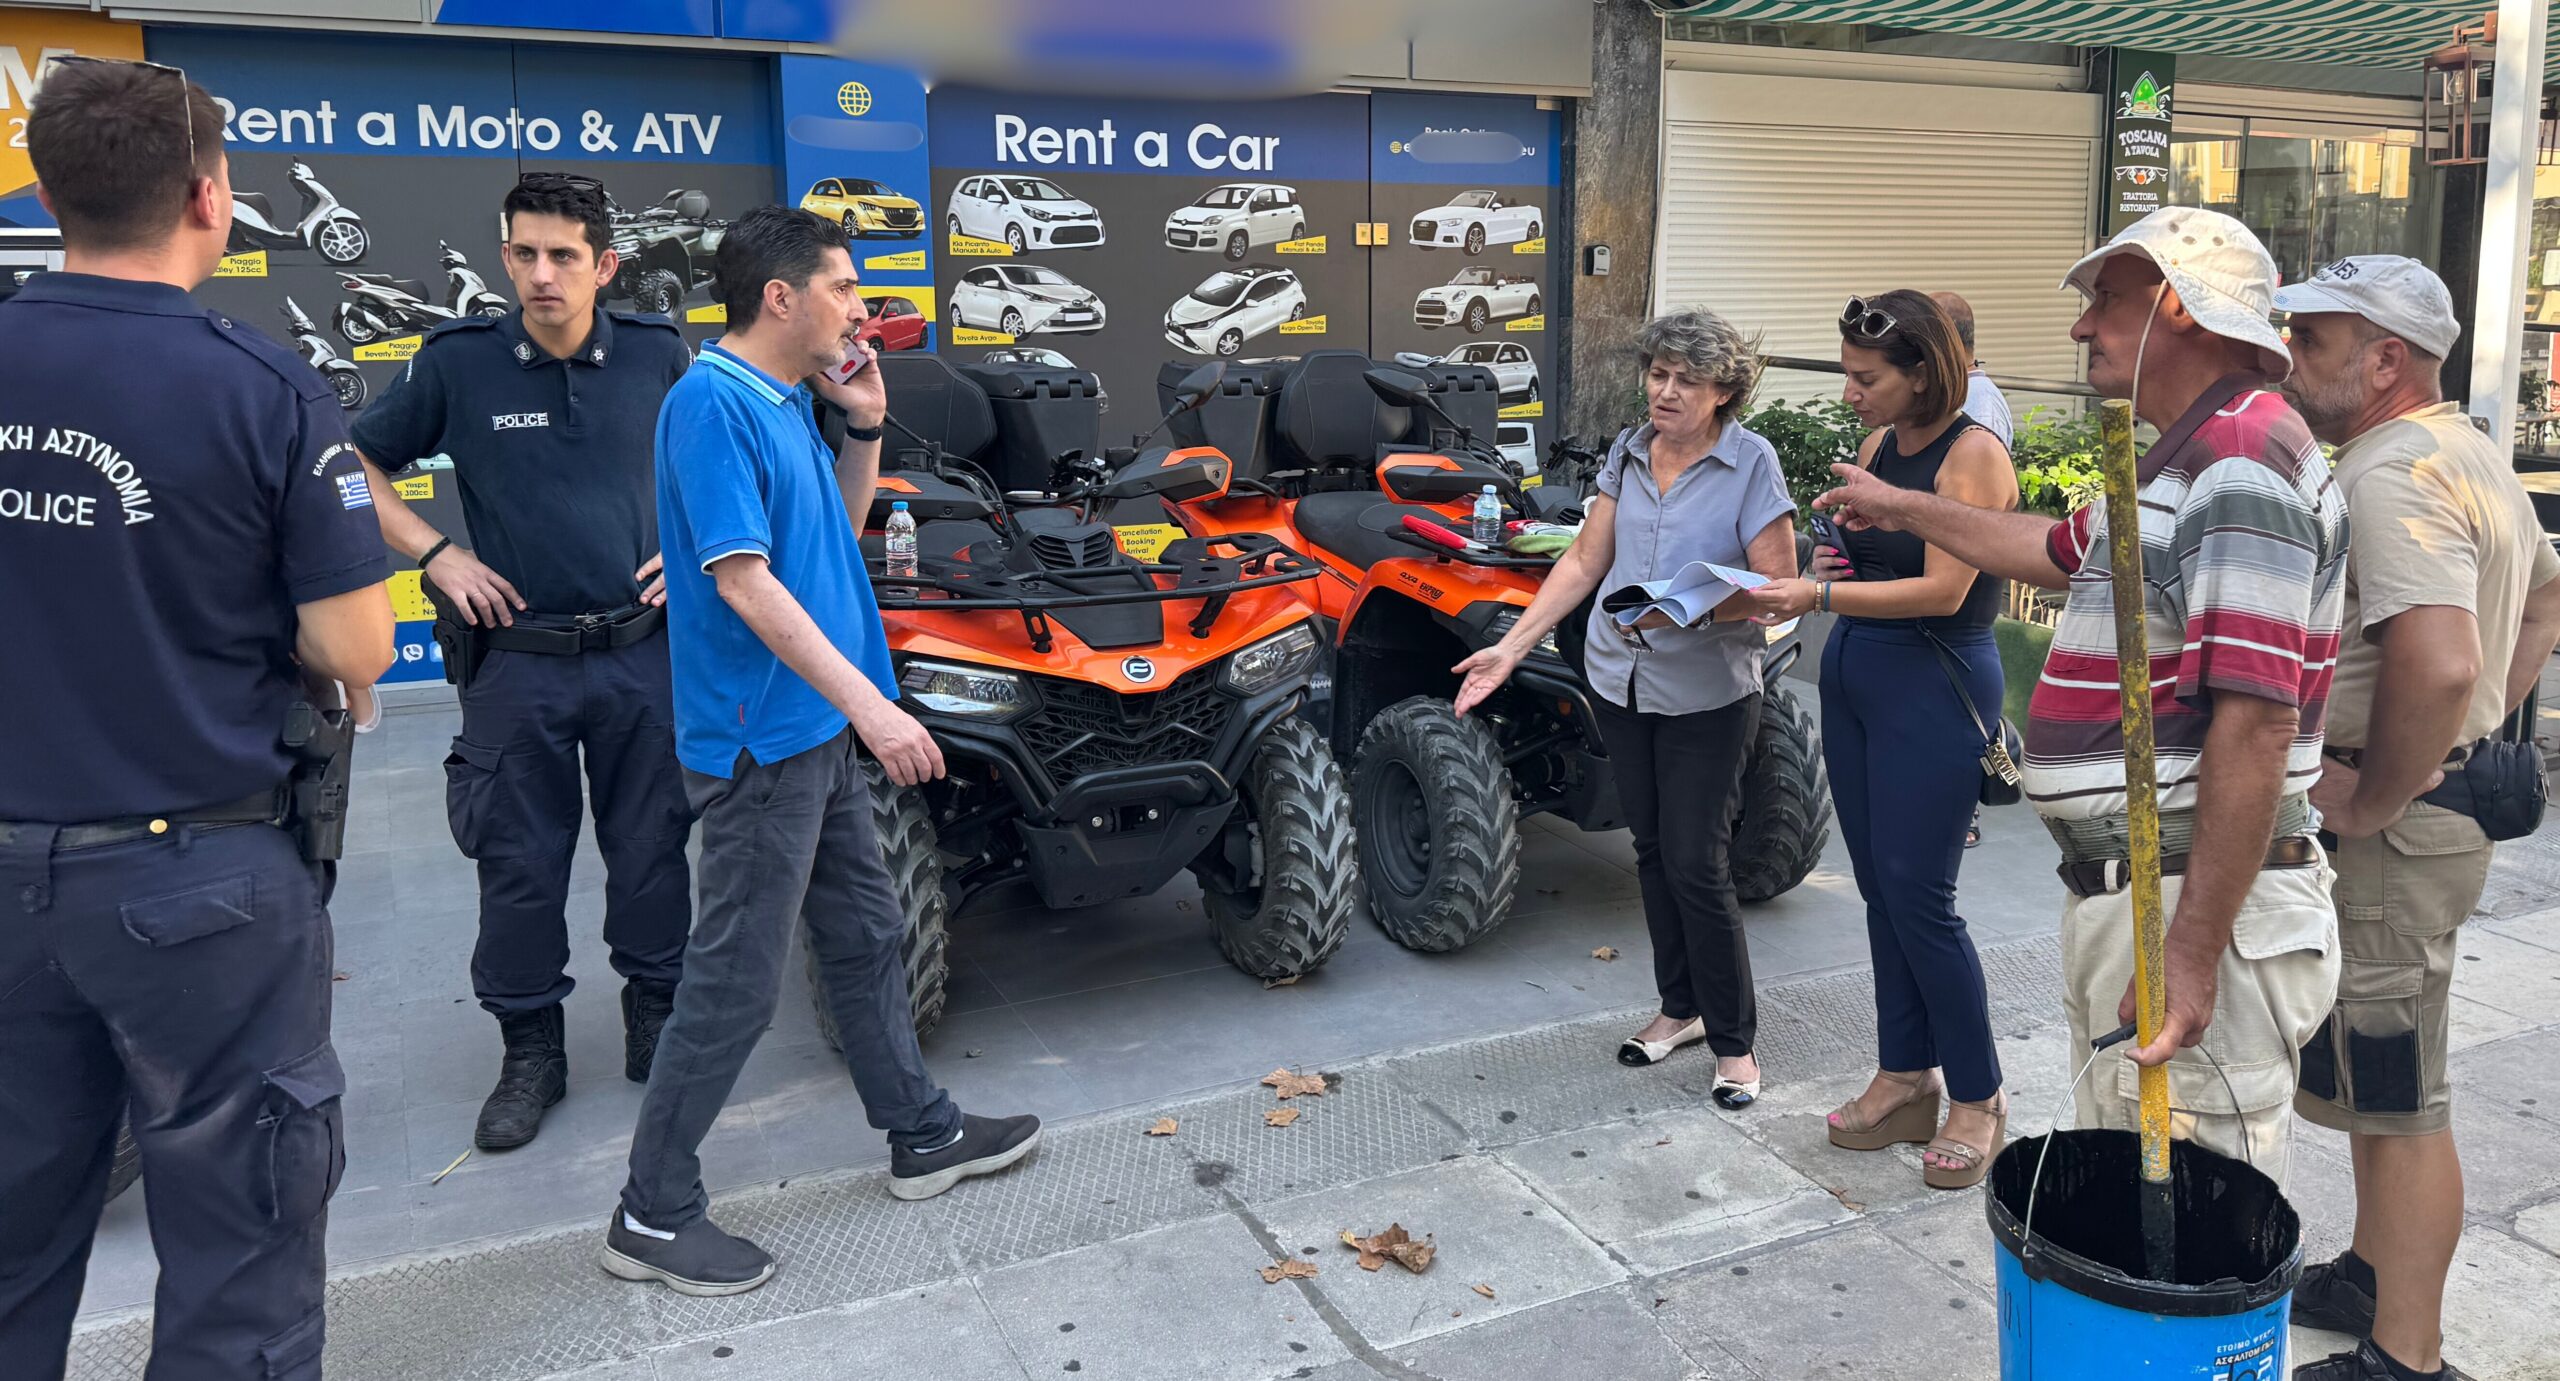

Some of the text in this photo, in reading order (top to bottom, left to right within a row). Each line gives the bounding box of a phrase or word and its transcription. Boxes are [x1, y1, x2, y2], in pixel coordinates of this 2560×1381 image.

[212, 97, 722, 155] Rent a Moto & ATV
[995, 114, 1280, 171] Rent a Car
[2119, 130, 2167, 148] TOSCANA
[2131, 146, 2159, 158] TAVOLA
[2123, 192, 2158, 201] TRATTORIA
[2120, 203, 2159, 213] RISTORANTE
[230, 258, 261, 267] Piaggio
[495, 413, 548, 428] POLICE
[42, 428, 154, 526] ΑΣΤΥΝΟΜΙΑ
[0, 488, 96, 526] OLICE
[1126, 538, 1155, 546] Booking
[2216, 1340, 2250, 1353] ΕΤΟΙΜΟ
